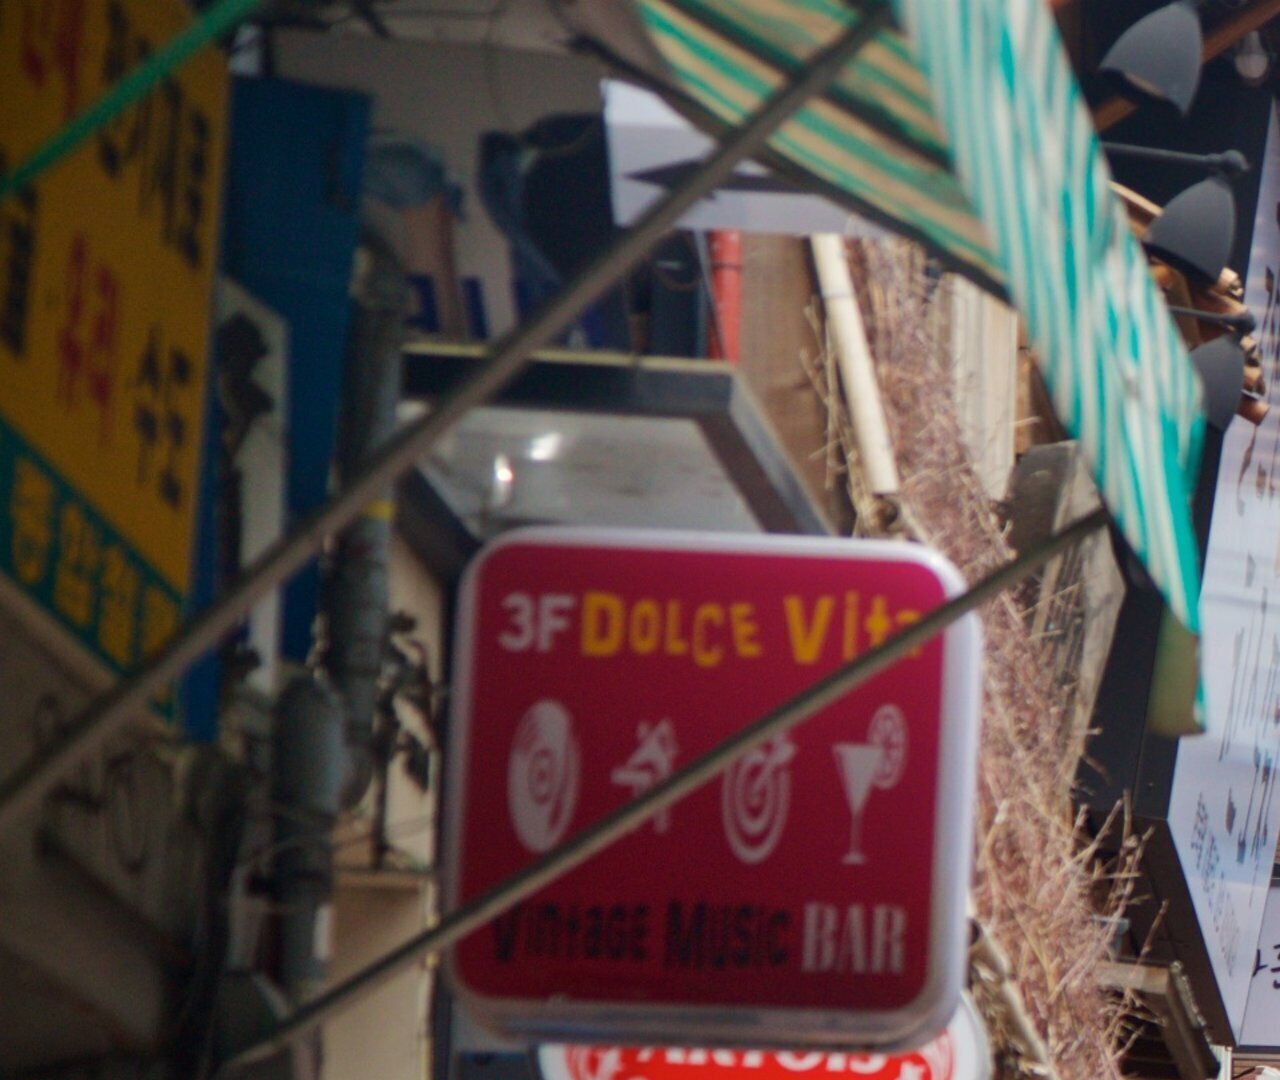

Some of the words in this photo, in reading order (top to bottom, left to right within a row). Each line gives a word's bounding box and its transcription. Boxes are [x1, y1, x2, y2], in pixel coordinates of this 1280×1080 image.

[498, 591, 574, 652] 3F
[580, 591, 763, 669] DOLCE
[801, 902, 908, 968] BAR
